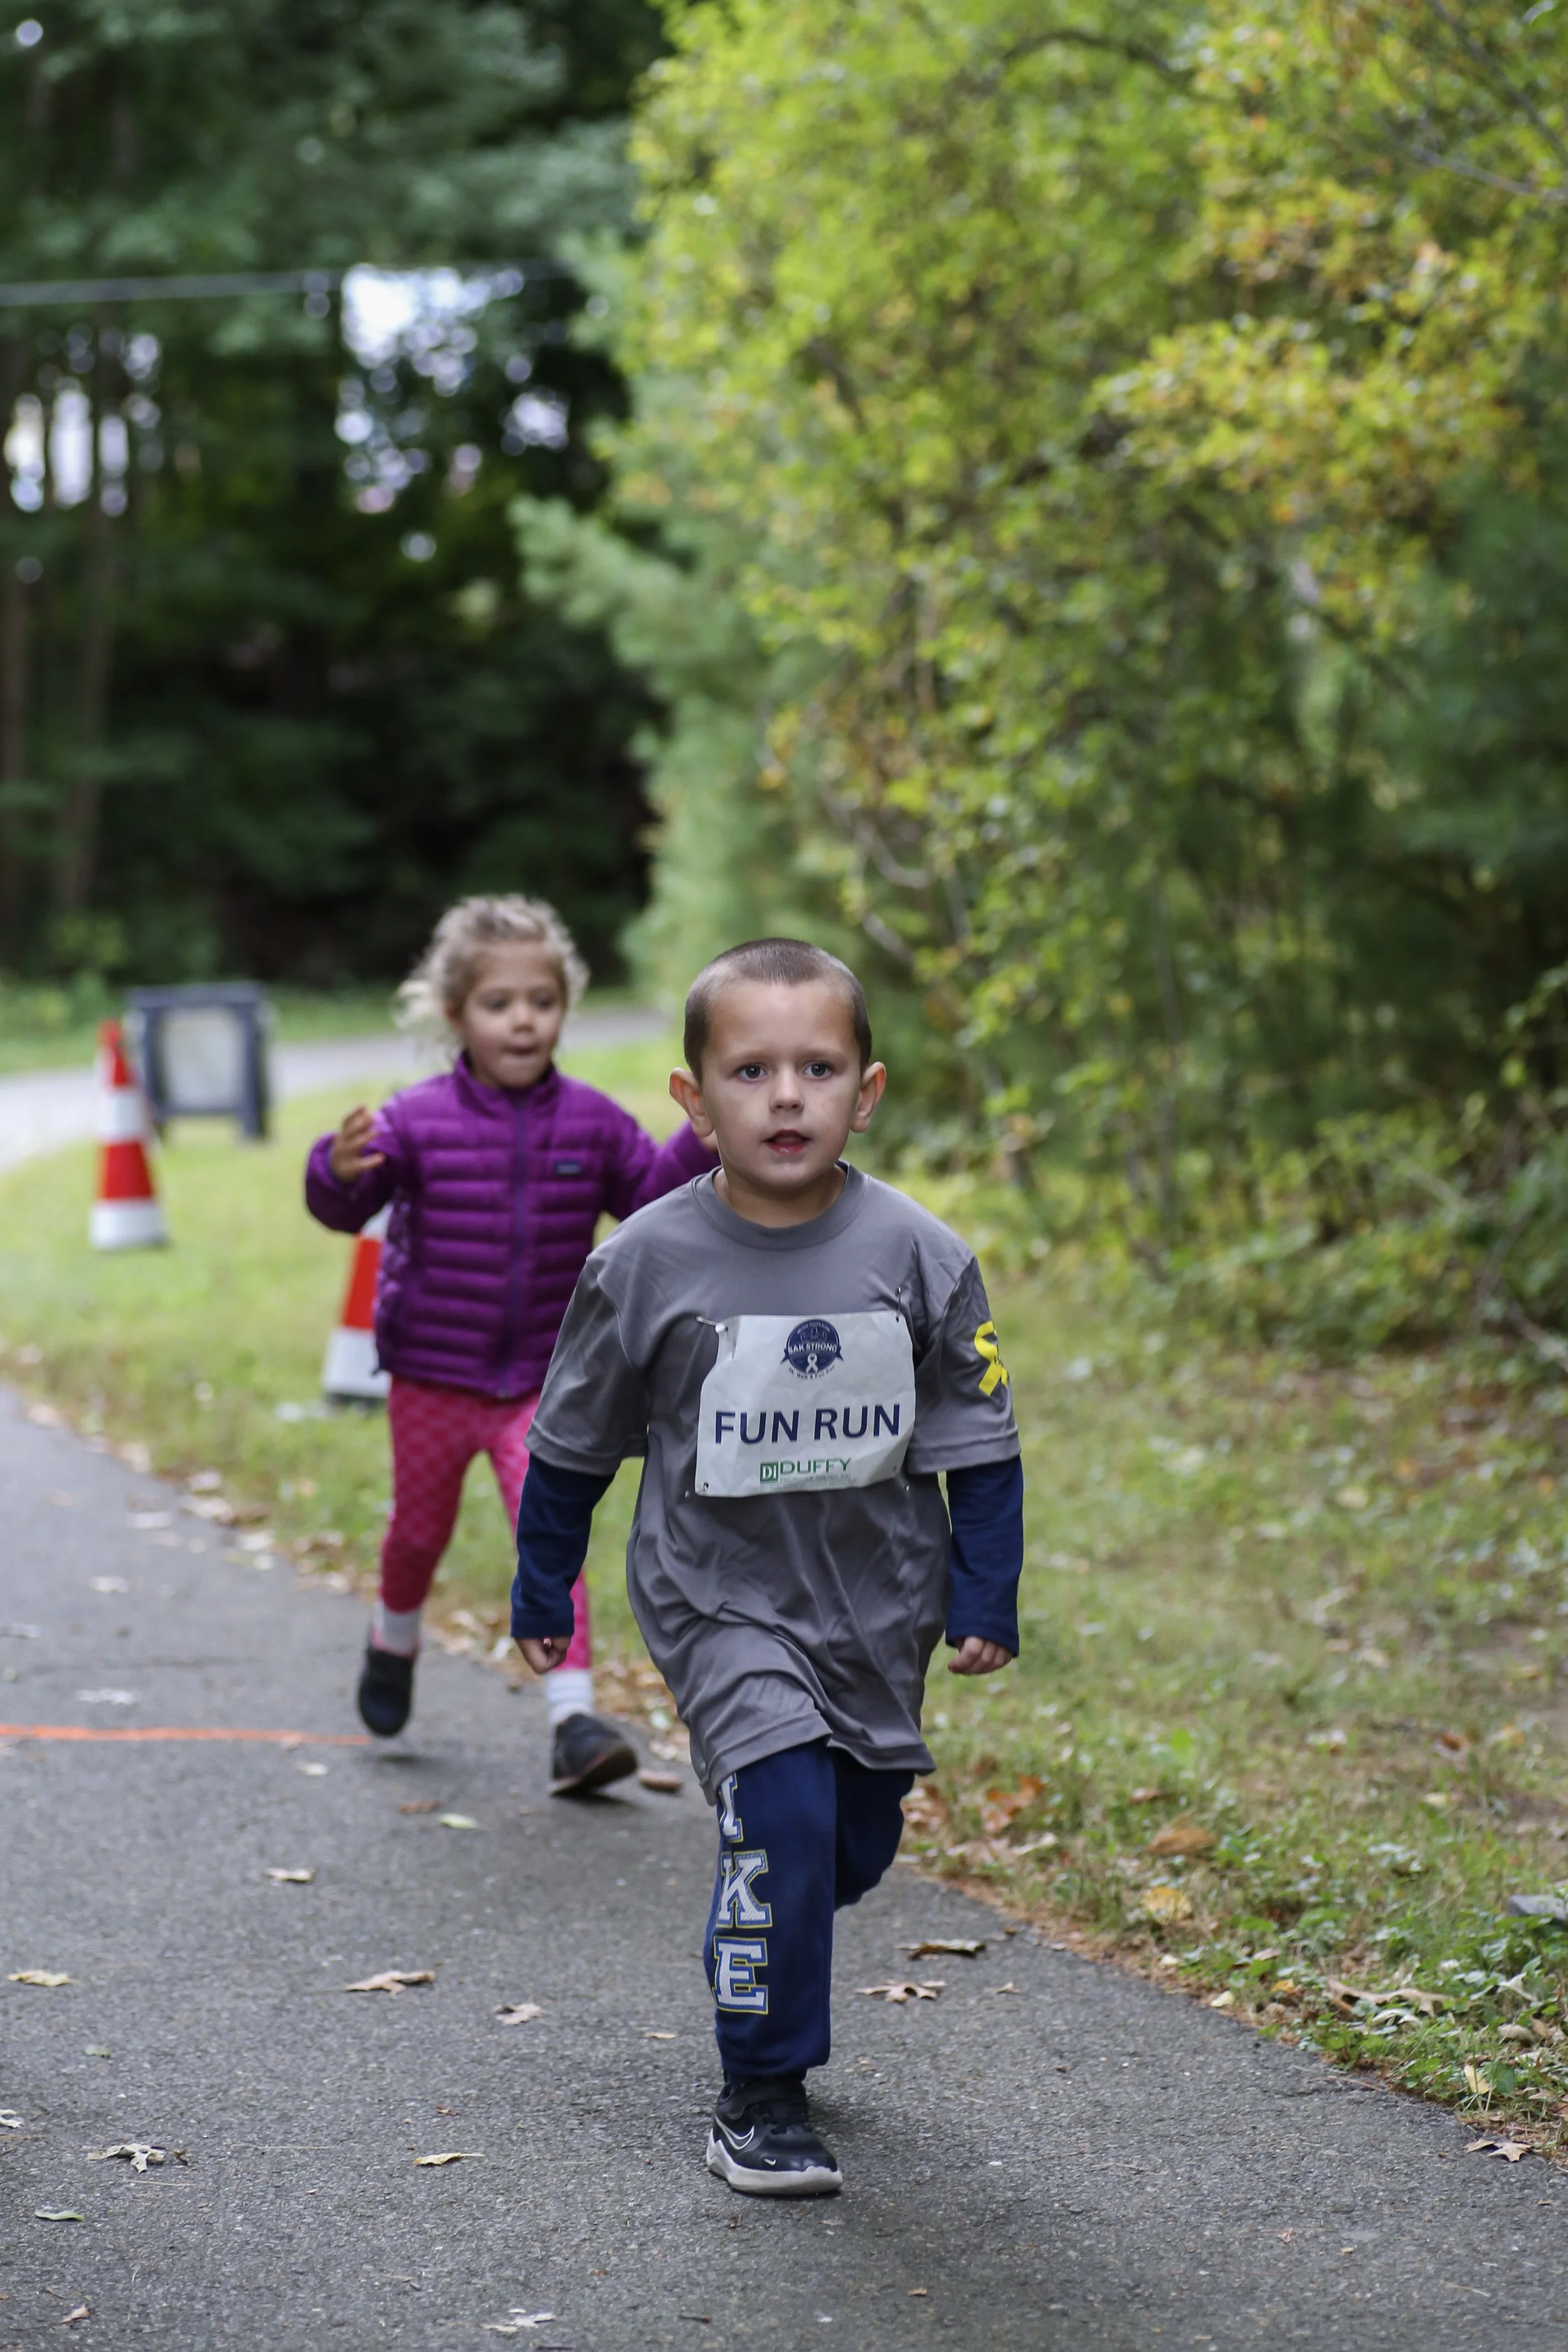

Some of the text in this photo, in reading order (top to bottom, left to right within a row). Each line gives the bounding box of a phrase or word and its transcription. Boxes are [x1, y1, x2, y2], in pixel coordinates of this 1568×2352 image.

[715, 1404, 901, 1445] FUN RUN
[780, 1457, 852, 1475] DUFFY
